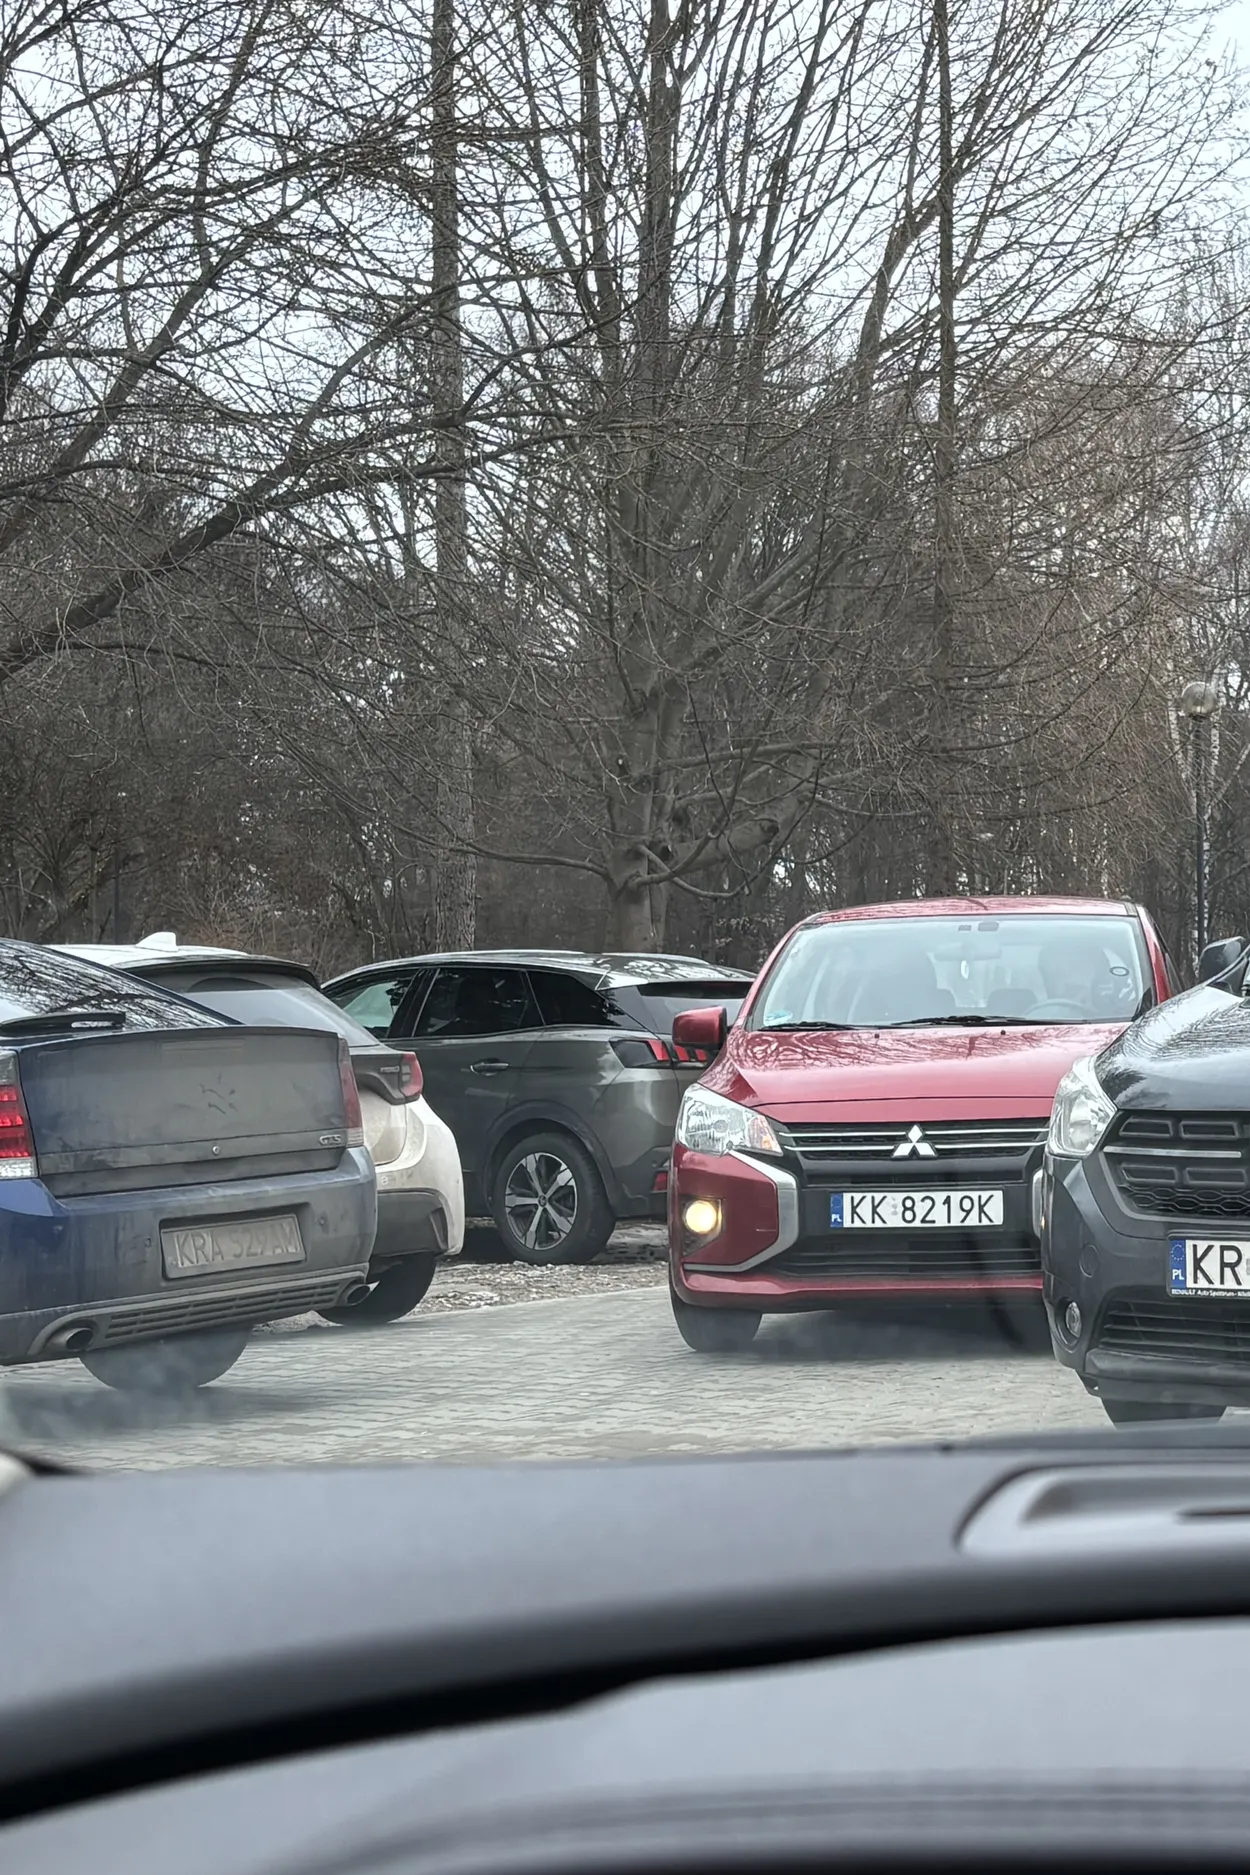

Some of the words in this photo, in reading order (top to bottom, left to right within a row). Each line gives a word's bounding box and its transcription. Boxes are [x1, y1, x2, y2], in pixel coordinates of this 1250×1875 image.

[831, 1213, 842, 1223] PL
[850, 1195, 887, 1224] KK
[901, 1194, 994, 1224] 8219K
[175, 1230, 225, 1268] KRA
[1172, 1269, 1185, 1281] PL
[1192, 1244, 1243, 1286] KR
